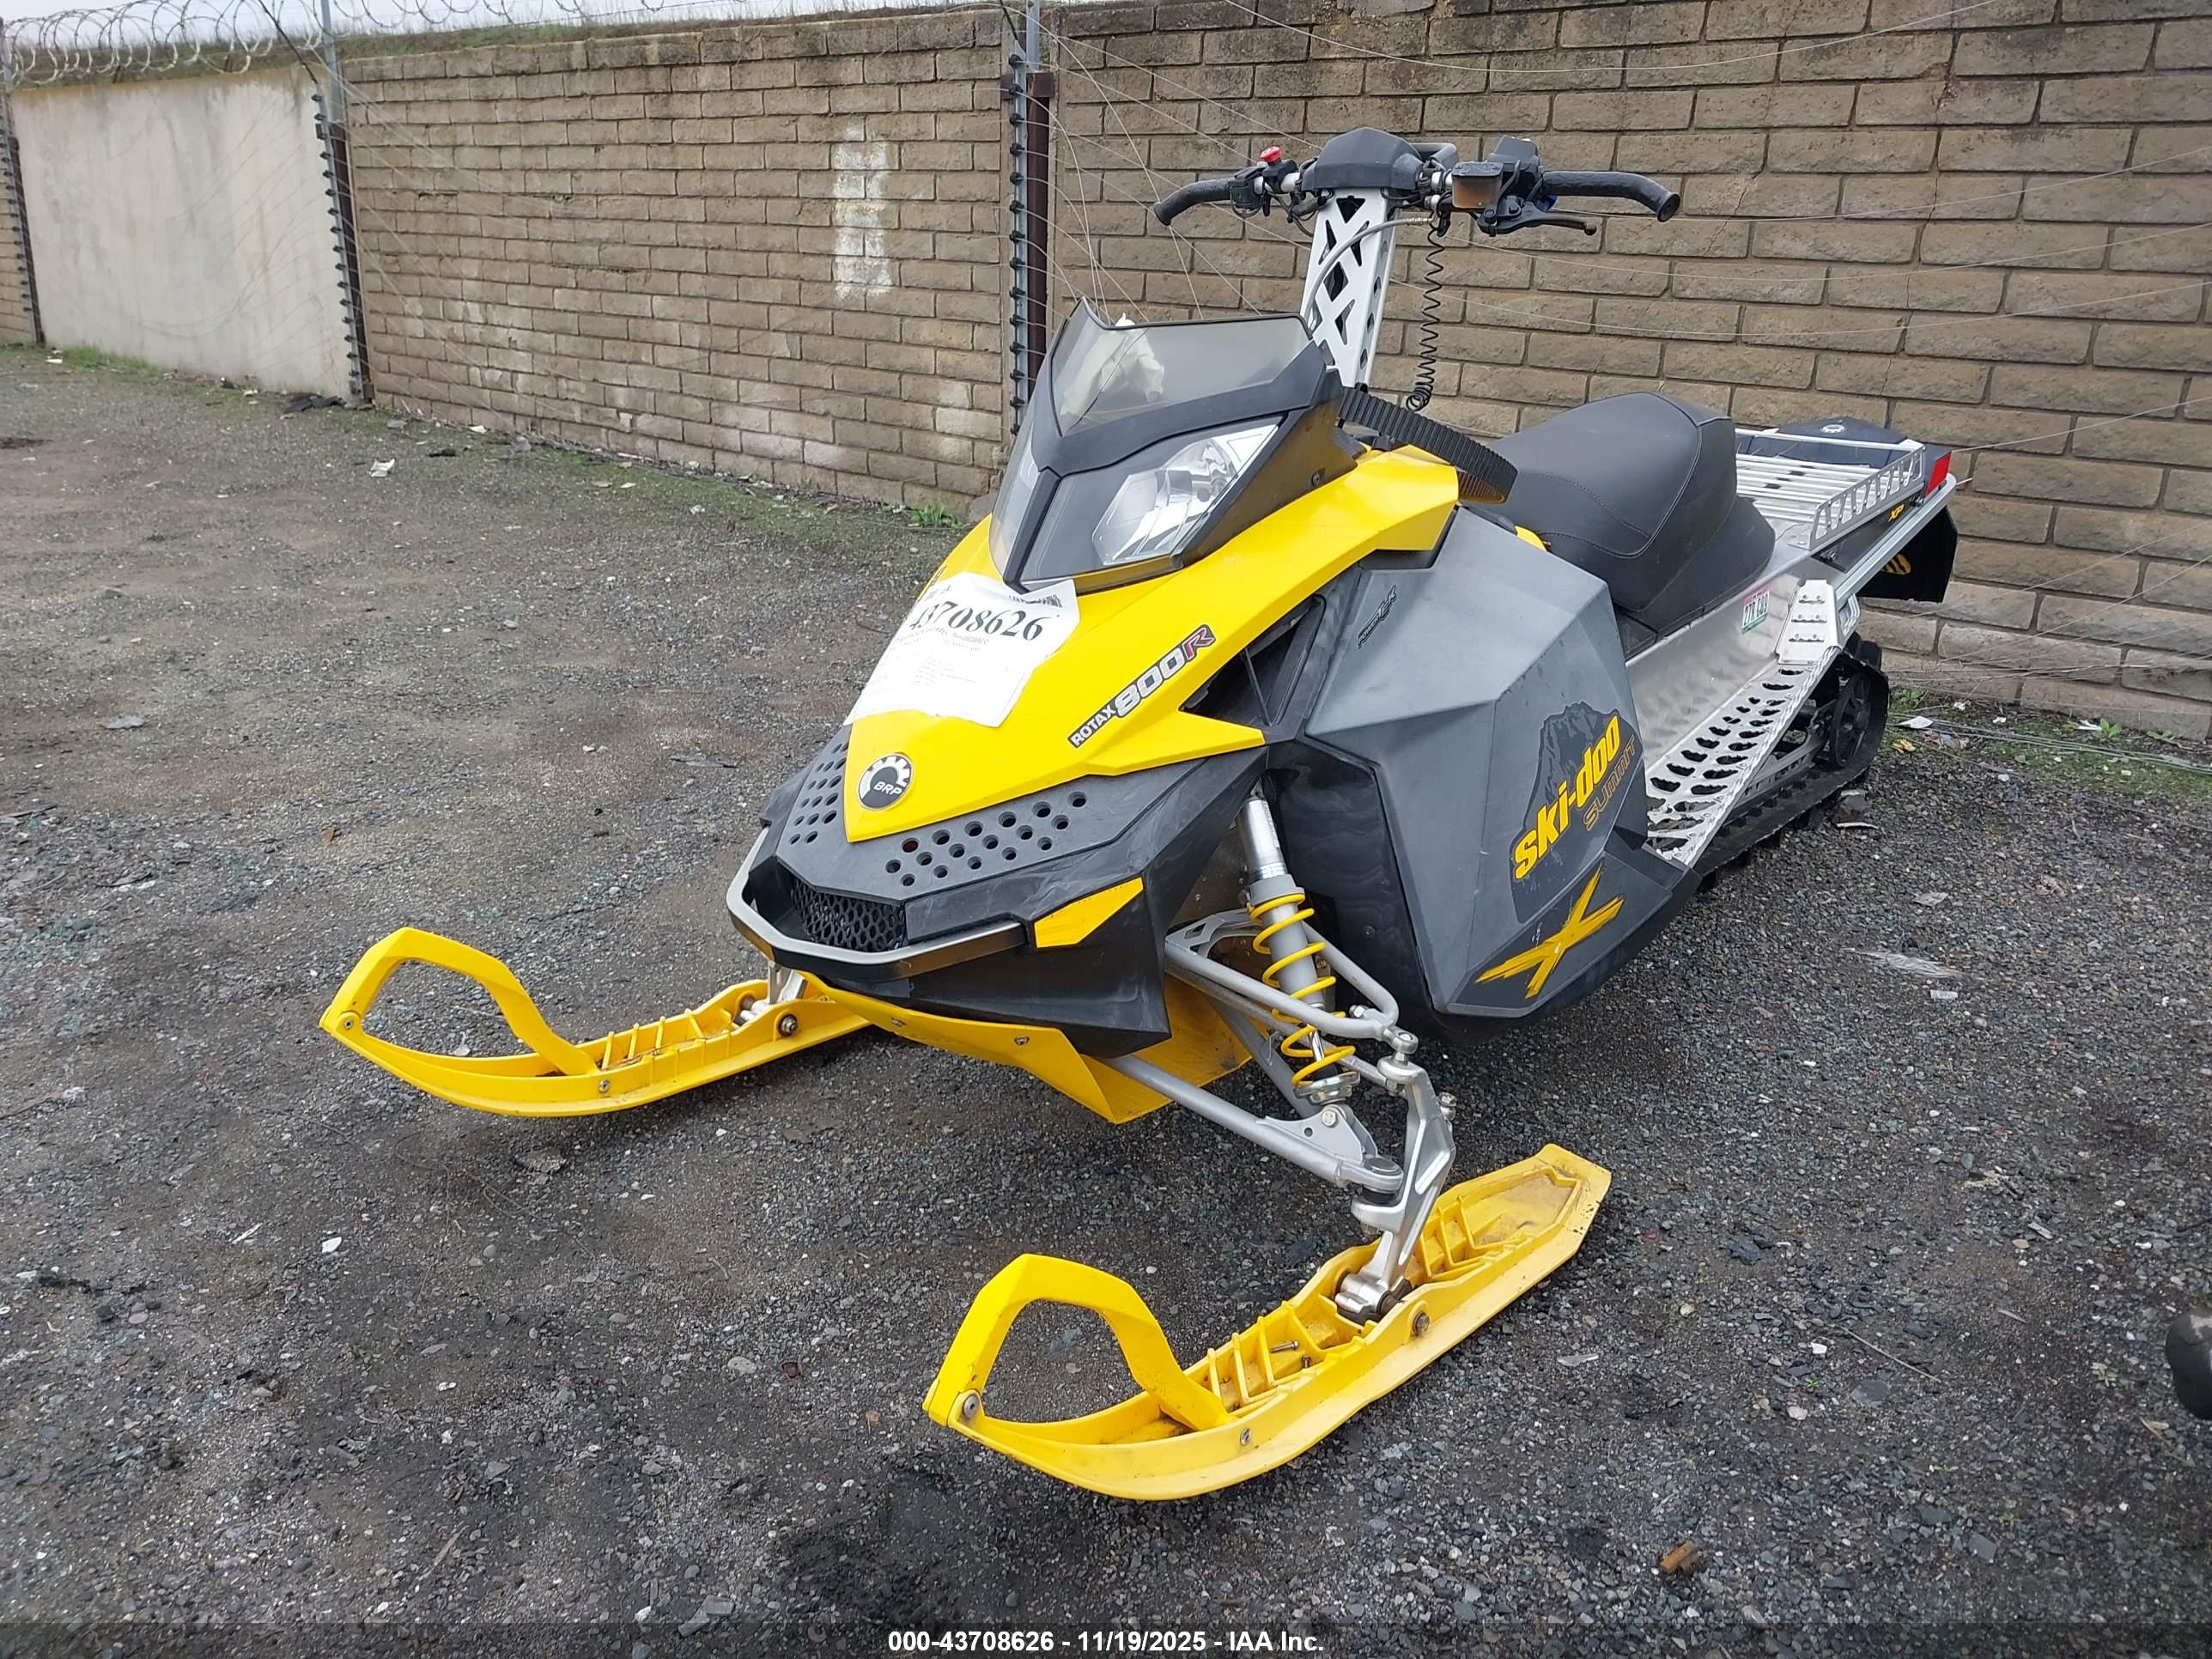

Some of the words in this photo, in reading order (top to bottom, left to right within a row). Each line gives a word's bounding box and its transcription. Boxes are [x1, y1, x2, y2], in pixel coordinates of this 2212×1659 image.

[1070, 704, 1116, 746] ROTAX
[873, 781, 902, 795] BRP
[1512, 714, 1621, 880] ski-doo
[1583, 735, 1635, 831] SUMMIT
